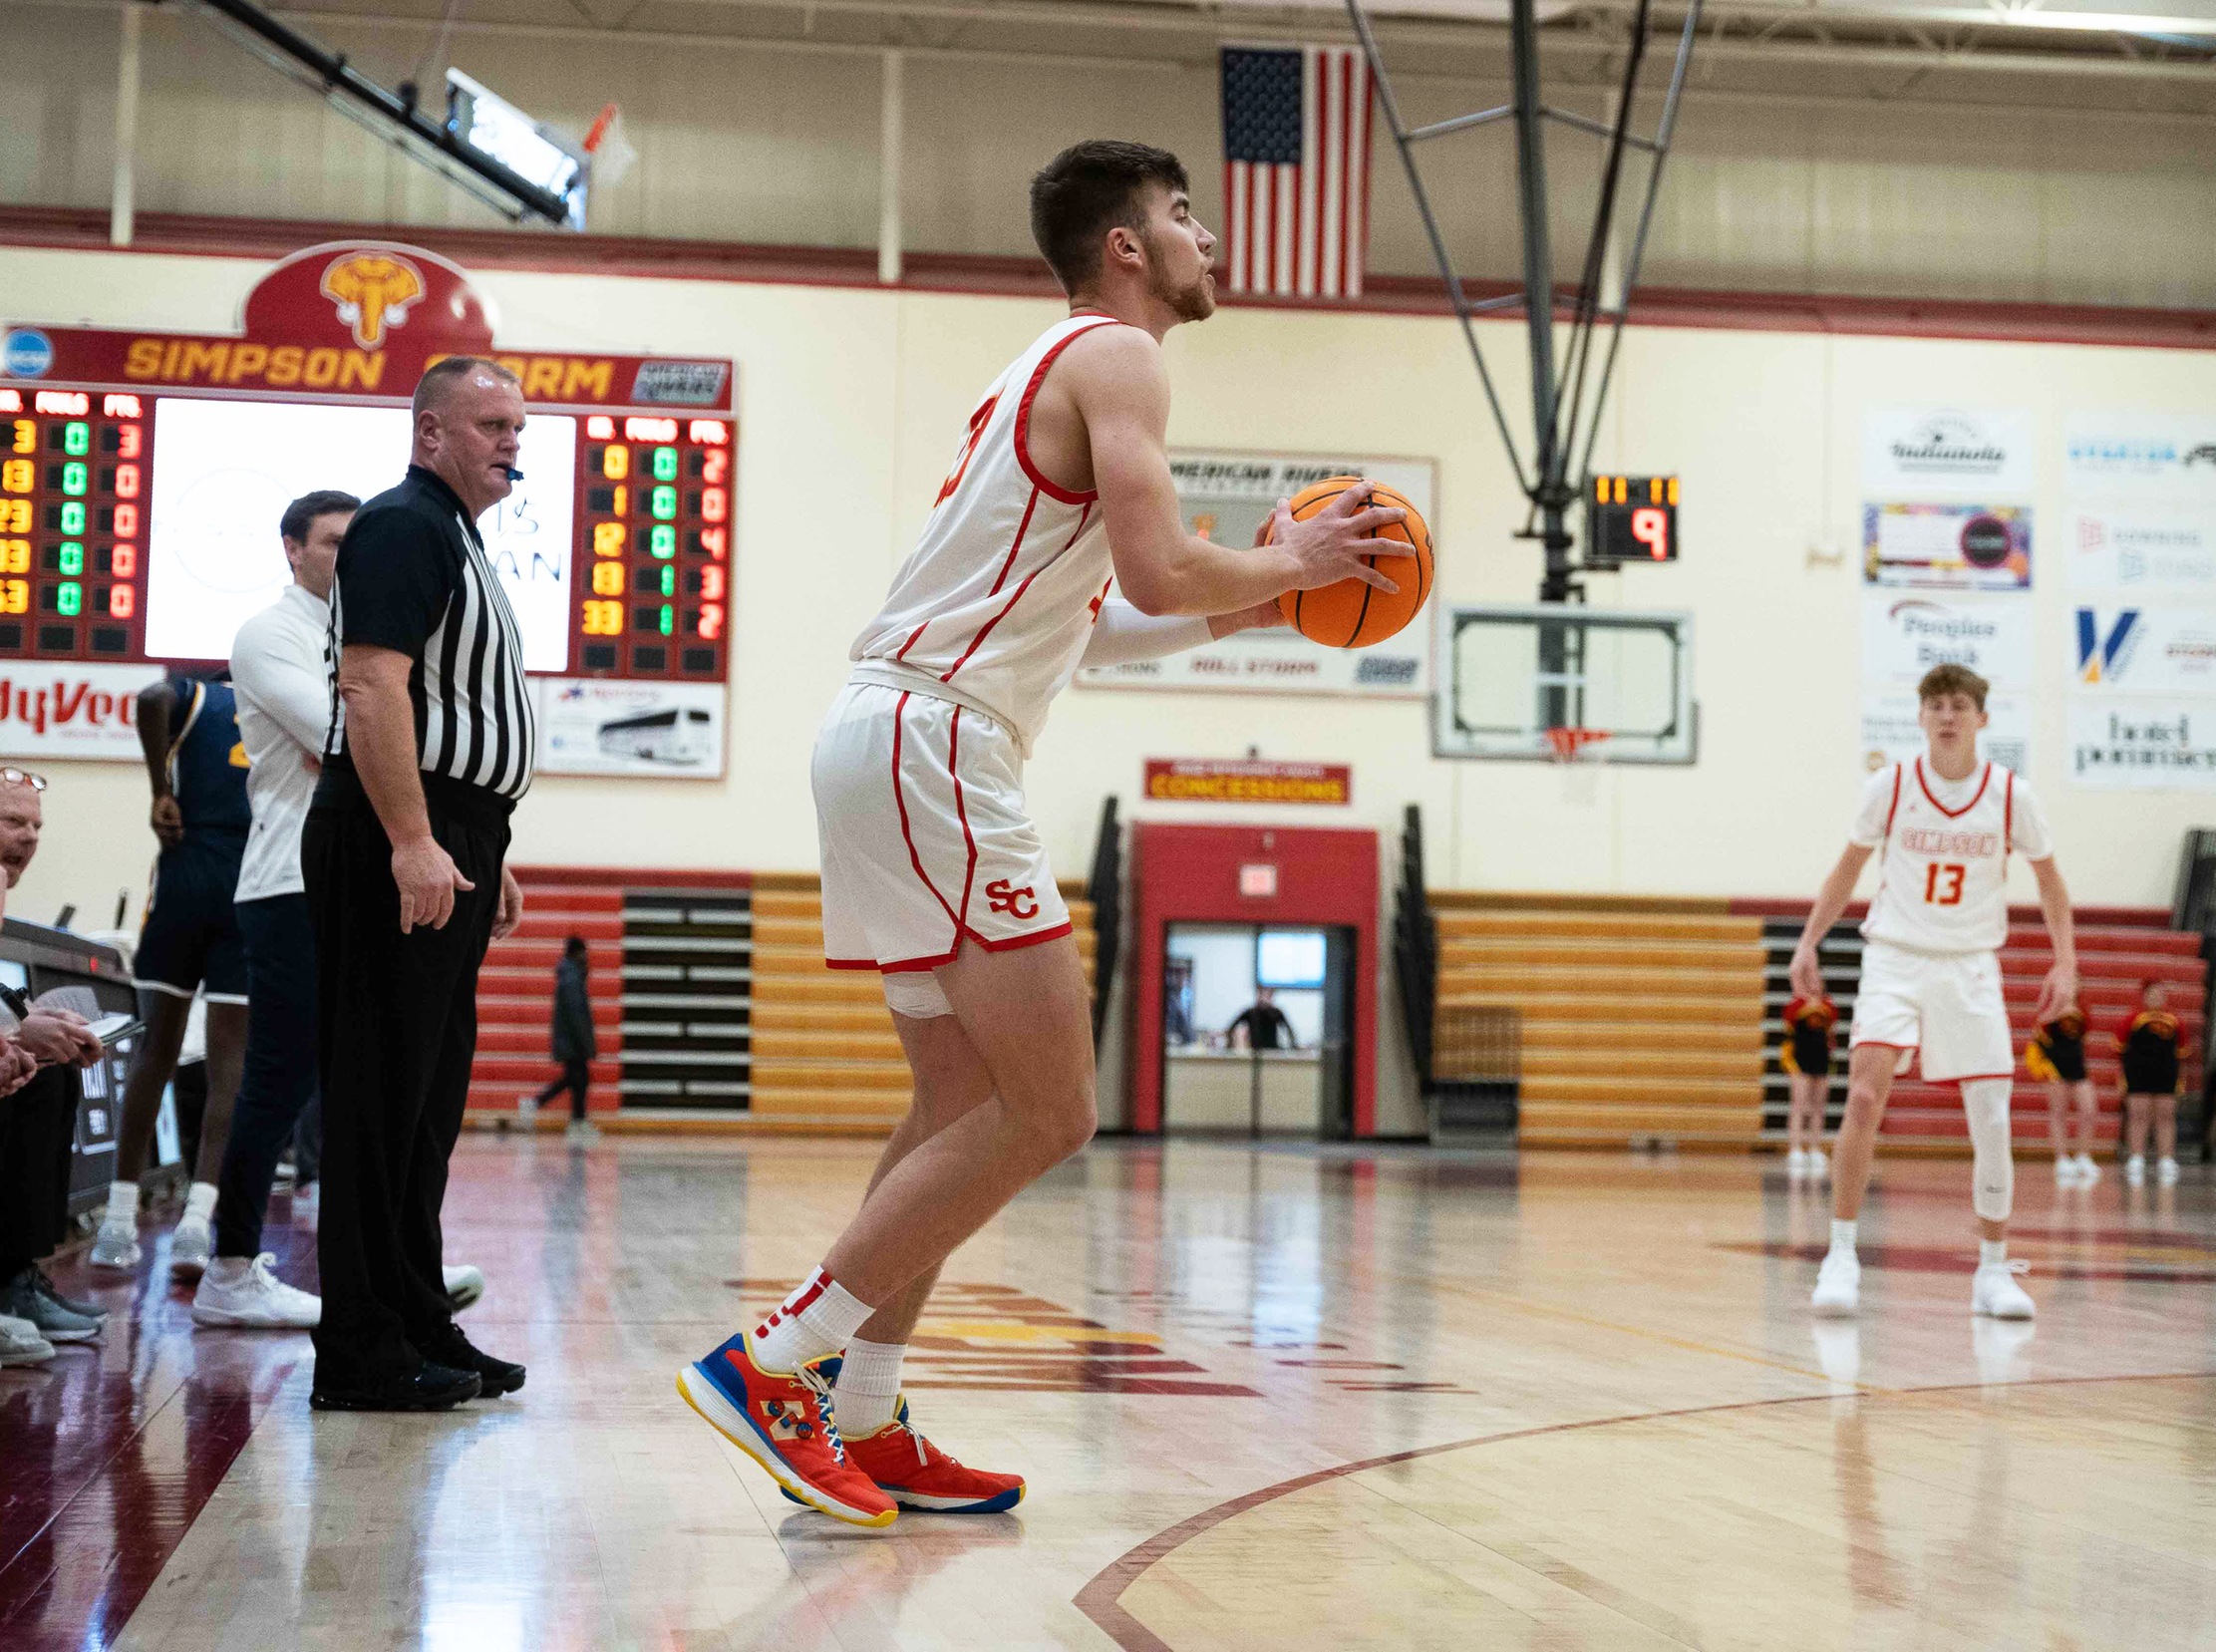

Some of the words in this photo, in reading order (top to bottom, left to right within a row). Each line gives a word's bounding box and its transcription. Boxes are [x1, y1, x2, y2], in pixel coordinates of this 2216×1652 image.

[124, 337, 385, 390] SIMPSON
[12, 419, 37, 455] 3
[64, 422, 90, 457] 0
[117, 424, 143, 460] 3
[62, 462, 88, 496] 0
[115, 464, 141, 499] 0
[603, 443, 630, 481] 0
[653, 447, 678, 482] 0
[702, 447, 729, 486] 2
[60, 500, 86, 536] 0
[113, 502, 139, 539] 0
[613, 485, 628, 517] 1
[651, 485, 677, 520] 0
[701, 487, 728, 523] 0
[650, 523, 676, 559] 0
[700, 525, 727, 561] 4
[1632, 507, 1668, 561] 9
[59, 541, 84, 576] 0
[112, 543, 138, 579] 0
[57, 581, 83, 616] 0
[110, 583, 136, 619] 0
[661, 564, 675, 597] 1
[700, 564, 725, 601] 3
[659, 603, 674, 636] 1
[698, 602, 725, 640] 2
[985, 877, 1040, 920] SC
[1924, 861, 1967, 906] 13
